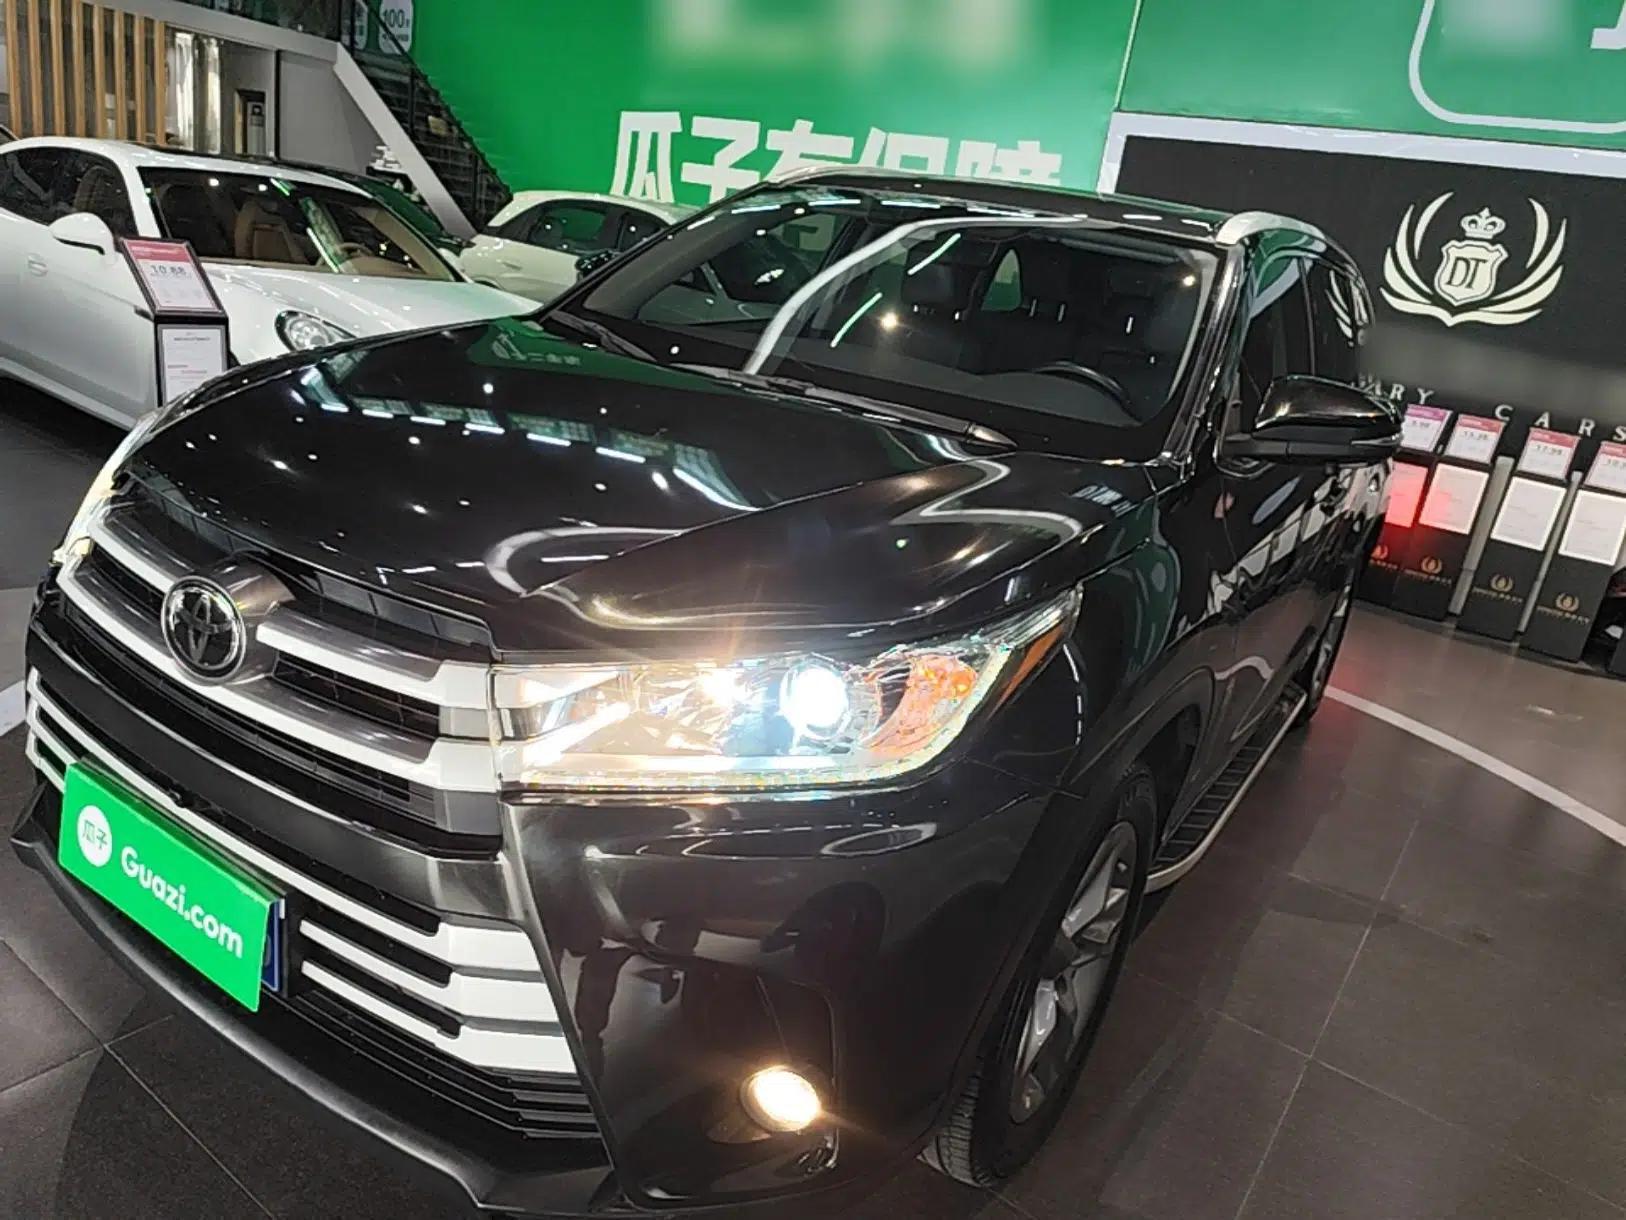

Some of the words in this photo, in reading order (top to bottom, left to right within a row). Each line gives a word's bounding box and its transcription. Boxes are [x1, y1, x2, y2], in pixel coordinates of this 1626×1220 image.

[1445, 256, 1488, 289] DT
[1494, 404, 1626, 441] CARS
[82, 819, 108, 850] 瓜子
[121, 845, 243, 959] Guazi.com
